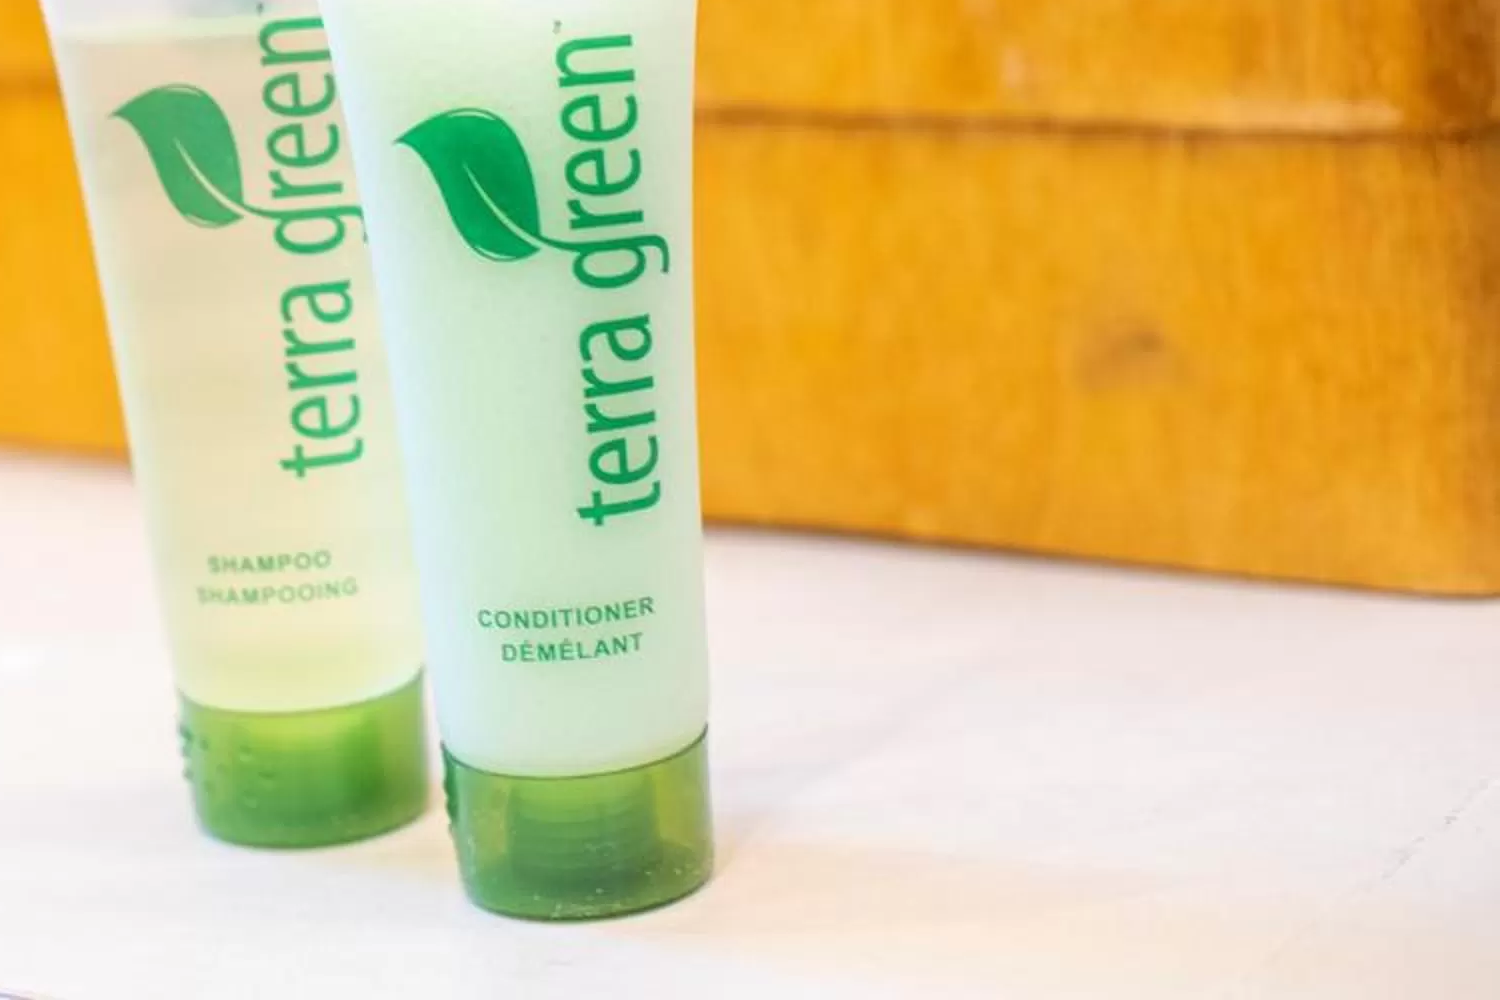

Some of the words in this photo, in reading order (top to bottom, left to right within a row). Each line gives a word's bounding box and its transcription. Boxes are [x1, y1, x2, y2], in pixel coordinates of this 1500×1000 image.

[259, 16, 367, 255] green
[555, 34, 670, 290] green
[279, 279, 364, 478] terra
[576, 314, 662, 527] terra
[197, 576, 358, 604] SHAMPOOING
[207, 549, 332, 574] SHAMPOO
[477, 596, 655, 630] CONDITIONER
